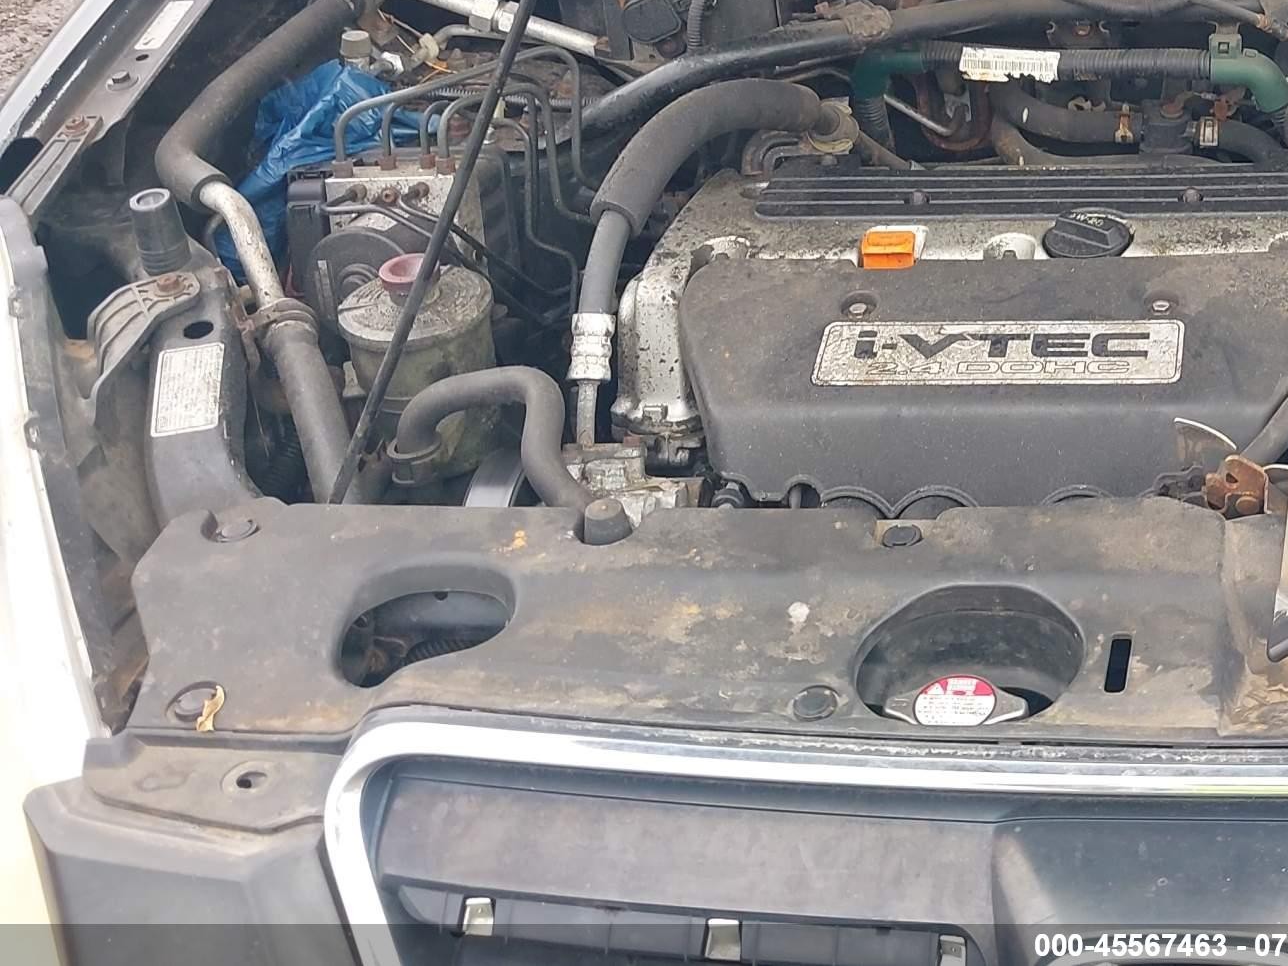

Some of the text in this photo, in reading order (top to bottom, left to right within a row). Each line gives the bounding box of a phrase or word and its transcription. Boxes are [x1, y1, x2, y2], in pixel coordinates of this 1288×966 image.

[853, 329, 1150, 360] i-VTEC
[867, 360, 1130, 375] 2.4 DOHC
